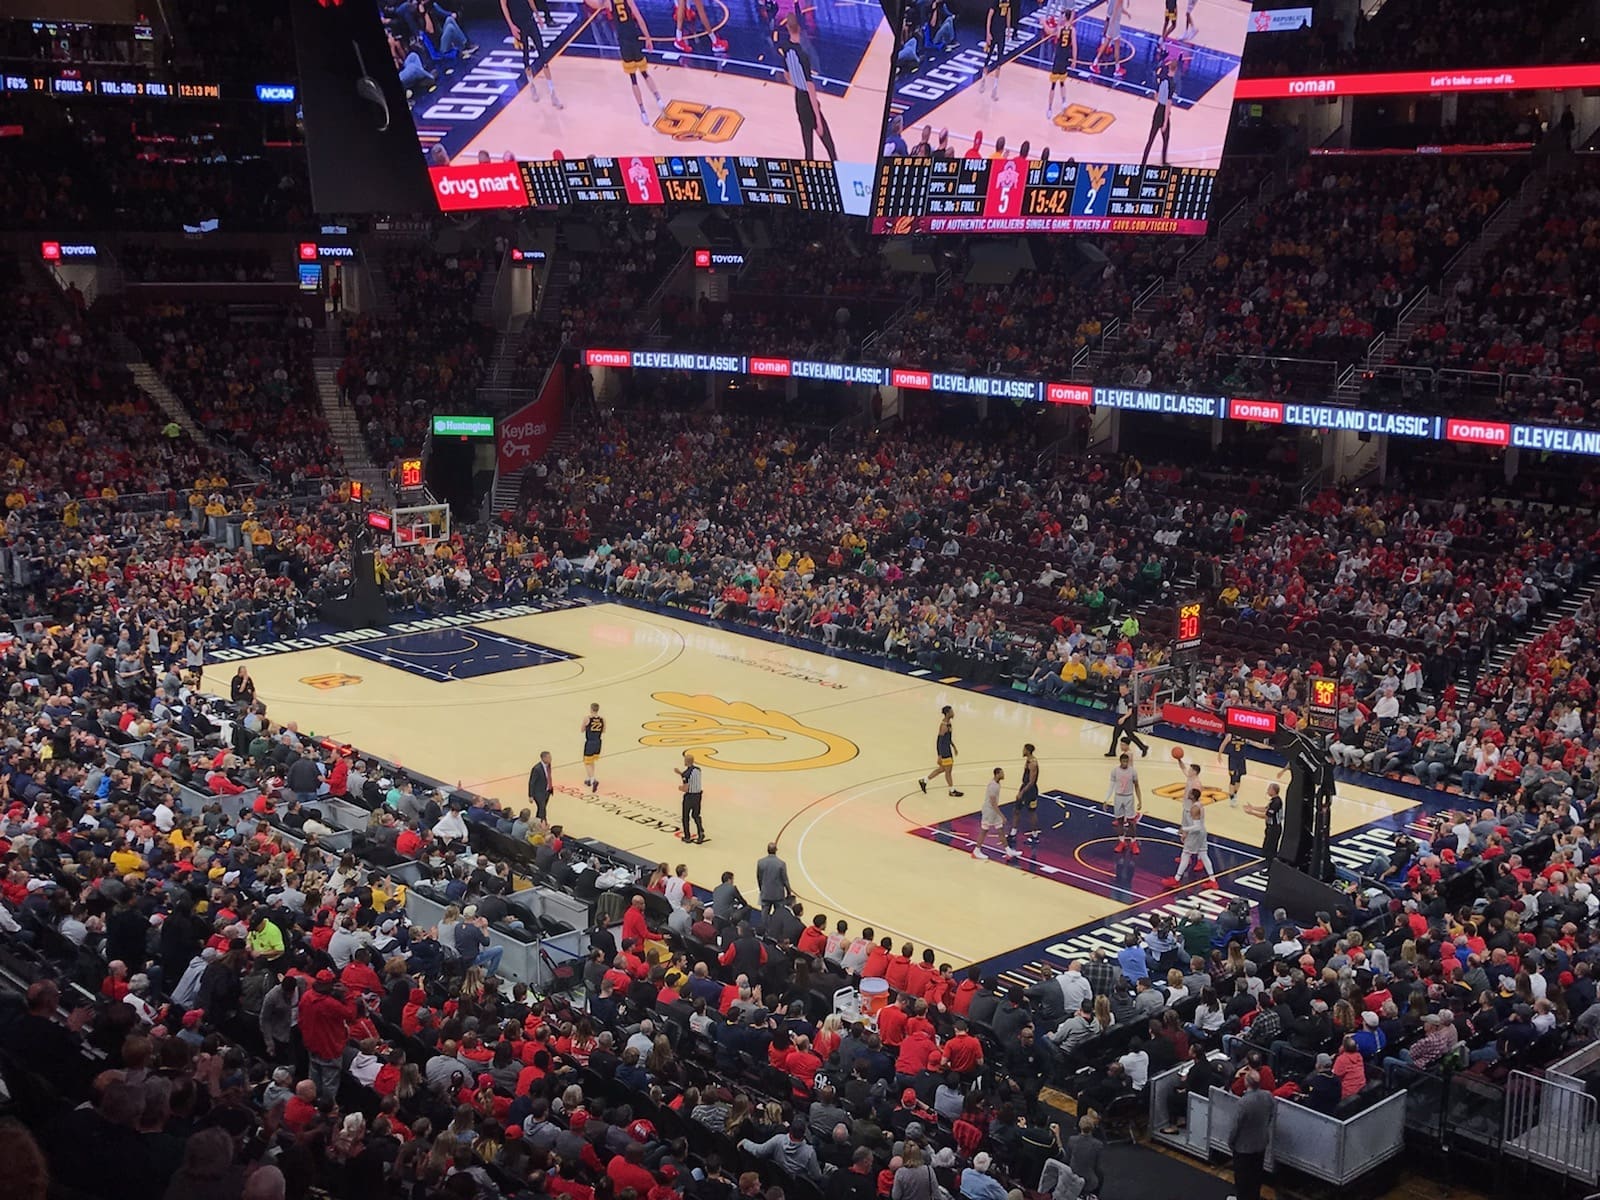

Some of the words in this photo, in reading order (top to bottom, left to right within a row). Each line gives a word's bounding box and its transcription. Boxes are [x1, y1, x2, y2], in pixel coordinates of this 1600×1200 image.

[6, 77, 28, 89] FG%
[33, 79, 44, 90] 17
[55, 80, 83, 92] FOULS
[85, 81, 92, 92] 4
[137, 83, 143, 94] 3
[146, 83, 167, 95] FULL
[168, 85, 173, 95] 1
[181, 85, 203, 97] 12:13
[204, 86, 218, 97] PM
[1289, 79, 1335, 93] roman
[1430, 77, 1451, 87] Let's
[1452, 76, 1471, 86] take
[1472, 76, 1492, 86] care
[1492, 75, 1503, 86] of
[1503, 74, 1514, 84] it.
[261, 87, 294, 100] NCAA
[652, 99, 745, 143] 50
[1052, 103, 1117, 134] 50
[964, 160, 987, 170] FOULS
[1064, 167, 1076, 181] 30
[1118, 164, 1140, 176] FOULS
[438, 176, 479, 199] drug
[479, 172, 520, 192] mart
[638, 180, 650, 201] 5
[666, 180, 701, 201] 15:42
[717, 180, 729, 202] 2
[960, 201, 975, 212] FULL
[998, 187, 1010, 213] 5
[1029, 189, 1067, 213] 15:42
[1084, 189, 1097, 214] 2
[930, 219, 946, 230] BUY
[946, 219, 986, 230] AUTHENTIC
[986, 219, 1025, 230] CAVALIERS
[1025, 219, 1051, 230] SINGLE
[1051, 219, 1071, 230] GAME
[1072, 219, 1100, 230] TICKETS
[1100, 219, 1111, 230] AT
[60, 246, 97, 255] TOYOTA
[318, 247, 354, 256] TOYOTA
[711, 255, 744, 263] TOYOTA
[589, 352, 628, 364] roman
[633, 353, 695, 369] CLEVELAND
[696, 356, 738, 372] CLASSIC
[753, 361, 787, 373] roman
[792, 361, 843, 378] CLEVELAND
[844, 366, 882, 384] CLASSIC
[895, 374, 928, 386] roman
[932, 375, 990, 394] CLEVELAND
[991, 381, 1034, 399] CLASSIC
[1051, 387, 1089, 400] roman
[1094, 389, 1161, 410] CLEVELAND
[1164, 395, 1214, 415] CLASSIC
[446, 421, 491, 433] Huntington
[1234, 403, 1279, 418] roman
[1285, 405, 1366, 430] CLEVELAND
[1367, 412, 1429, 436] CLASSIC
[1452, 424, 1505, 441] roman
[403, 470, 420, 486] 30
[209, 628, 388, 661] CLEVELAND
[389, 604, 541, 633] CAVALIERS
[1180, 617, 1197, 639] 30
[1317, 691, 1331, 705] 30
[590, 721, 602, 732] 22
[1234, 713, 1270, 727] roman
